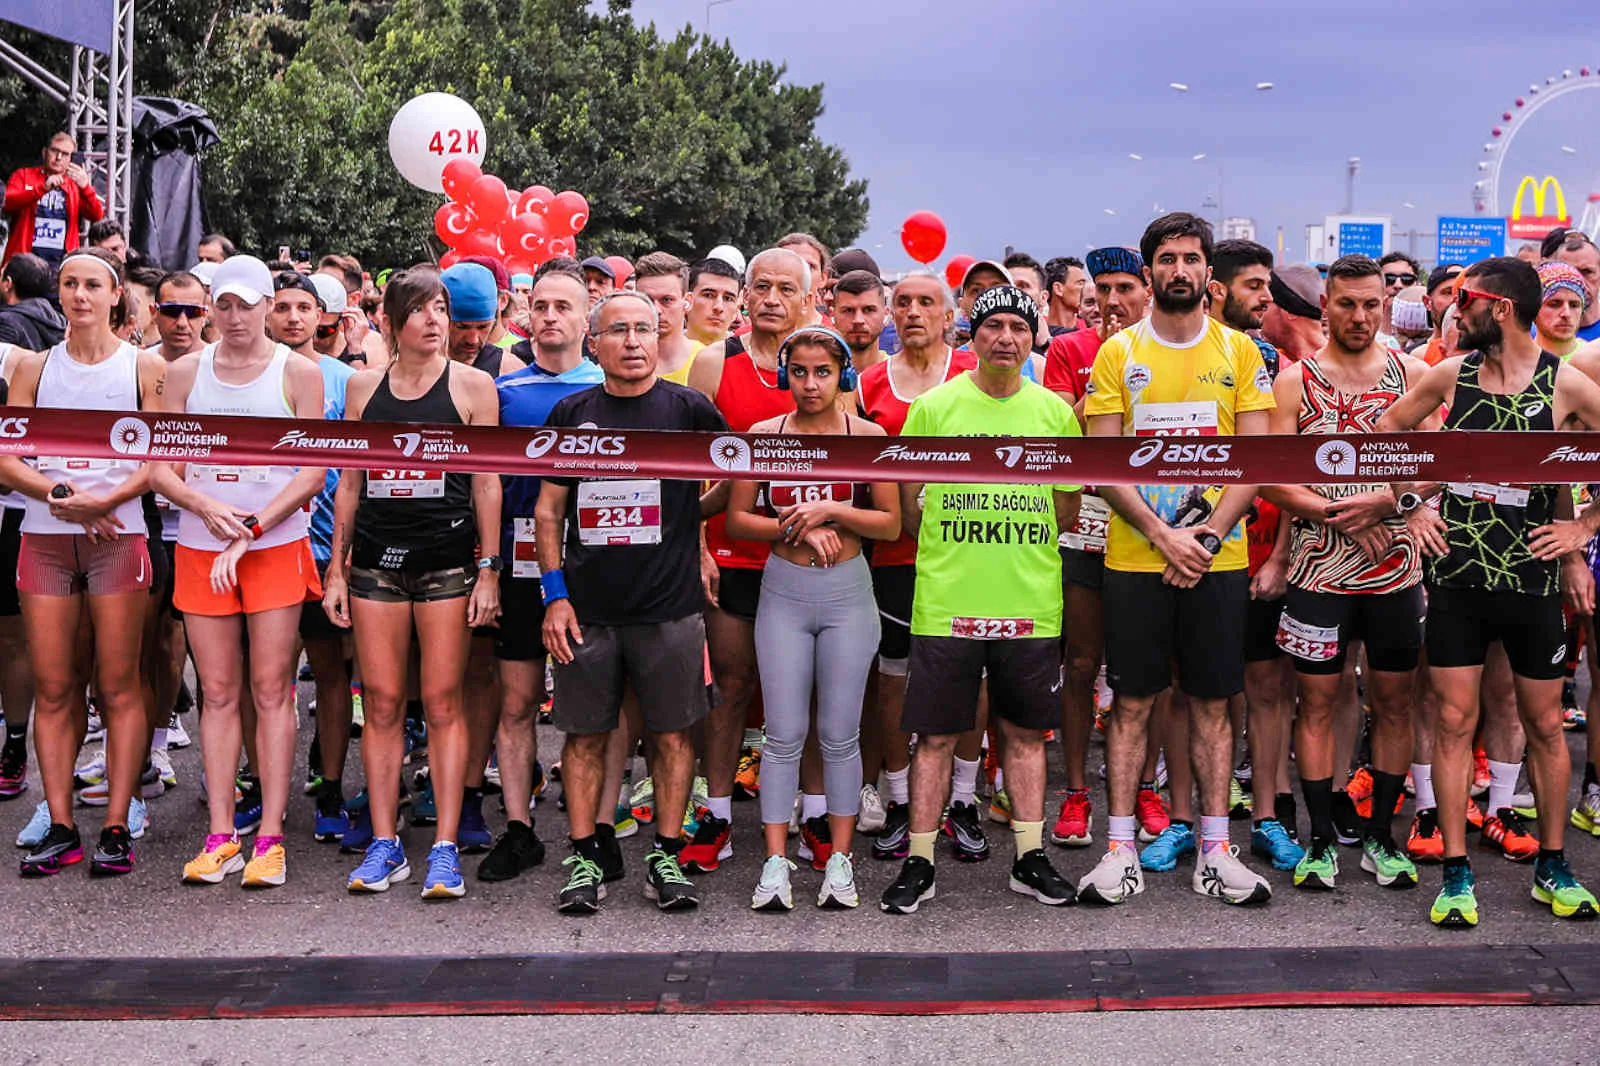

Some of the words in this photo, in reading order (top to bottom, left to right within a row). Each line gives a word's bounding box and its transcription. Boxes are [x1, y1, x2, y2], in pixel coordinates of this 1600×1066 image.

[428, 129, 479, 155] 42K
[0, 417, 29, 438] CS
[154, 420, 202, 432] ANTALYA
[153, 431, 228, 446] BÜYÜKŞEHİR
[298, 437, 369, 450] RUNTALYA
[558, 434, 626, 456] asics
[753, 438, 802, 447] ANTALYA
[150, 445, 212, 458] BELEDİYESİ
[423, 443, 470, 453] ANTALYA
[1360, 442, 1410, 451] ANTALYA
[422, 453, 449, 461] Airport
[753, 447, 829, 462] BÜYÜKŞEHİR
[898, 450, 972, 462] RUNTALYA
[1025, 454, 1073, 464] ANTALYA
[1162, 444, 1232, 463] asics
[1360, 450, 1434, 465] BÜYÜKŞEHİR
[620, 461, 640, 472] body
[753, 461, 813, 473] BELEDİYESİ
[1025, 464, 1052, 472] Airport
[1359, 464, 1418, 476] BELEDİYESİ
[1157, 468, 1180, 476] sound
[1201, 468, 1224, 476] sound
[1224, 468, 1243, 479] body
[790, 484, 834, 504] 161
[942, 493, 989, 514] BAŞIMIZ
[596, 507, 643, 527] 234
[972, 620, 1017, 637] 323
[1284, 633, 1326, 658] 232
